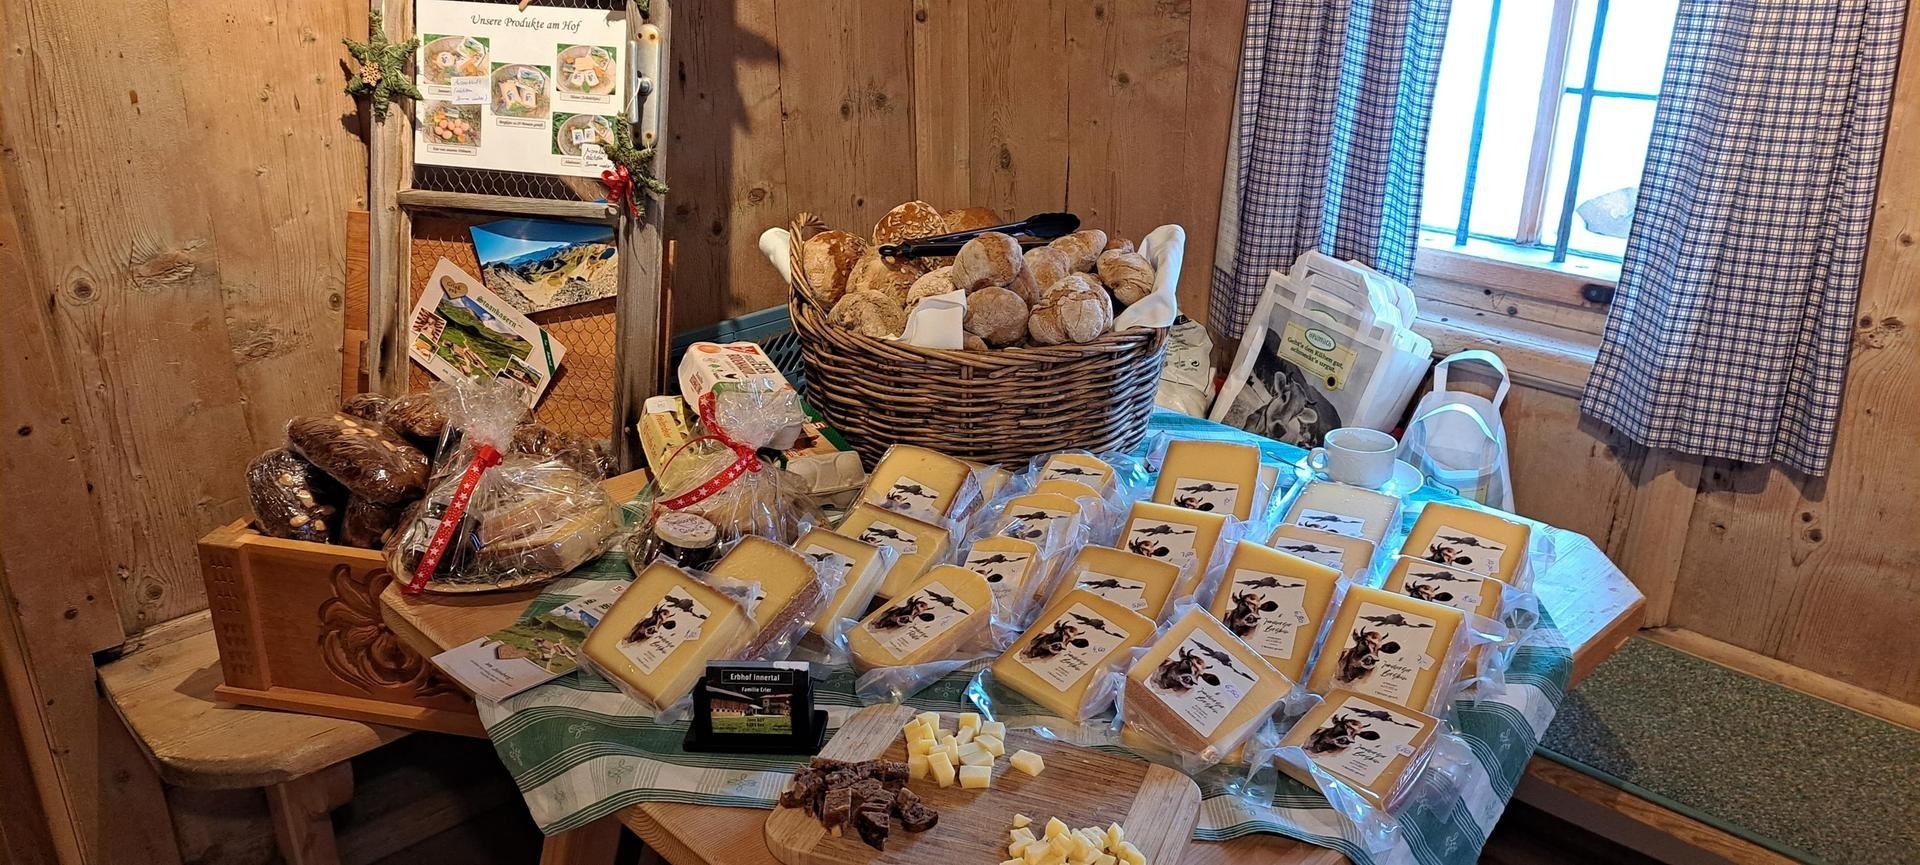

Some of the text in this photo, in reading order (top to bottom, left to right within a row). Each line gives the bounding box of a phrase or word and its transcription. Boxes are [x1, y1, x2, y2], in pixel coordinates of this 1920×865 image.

[470, 14, 583, 34] Unsere Produkte am Hof
[730, 673, 780, 681] Erbhof Innertal
